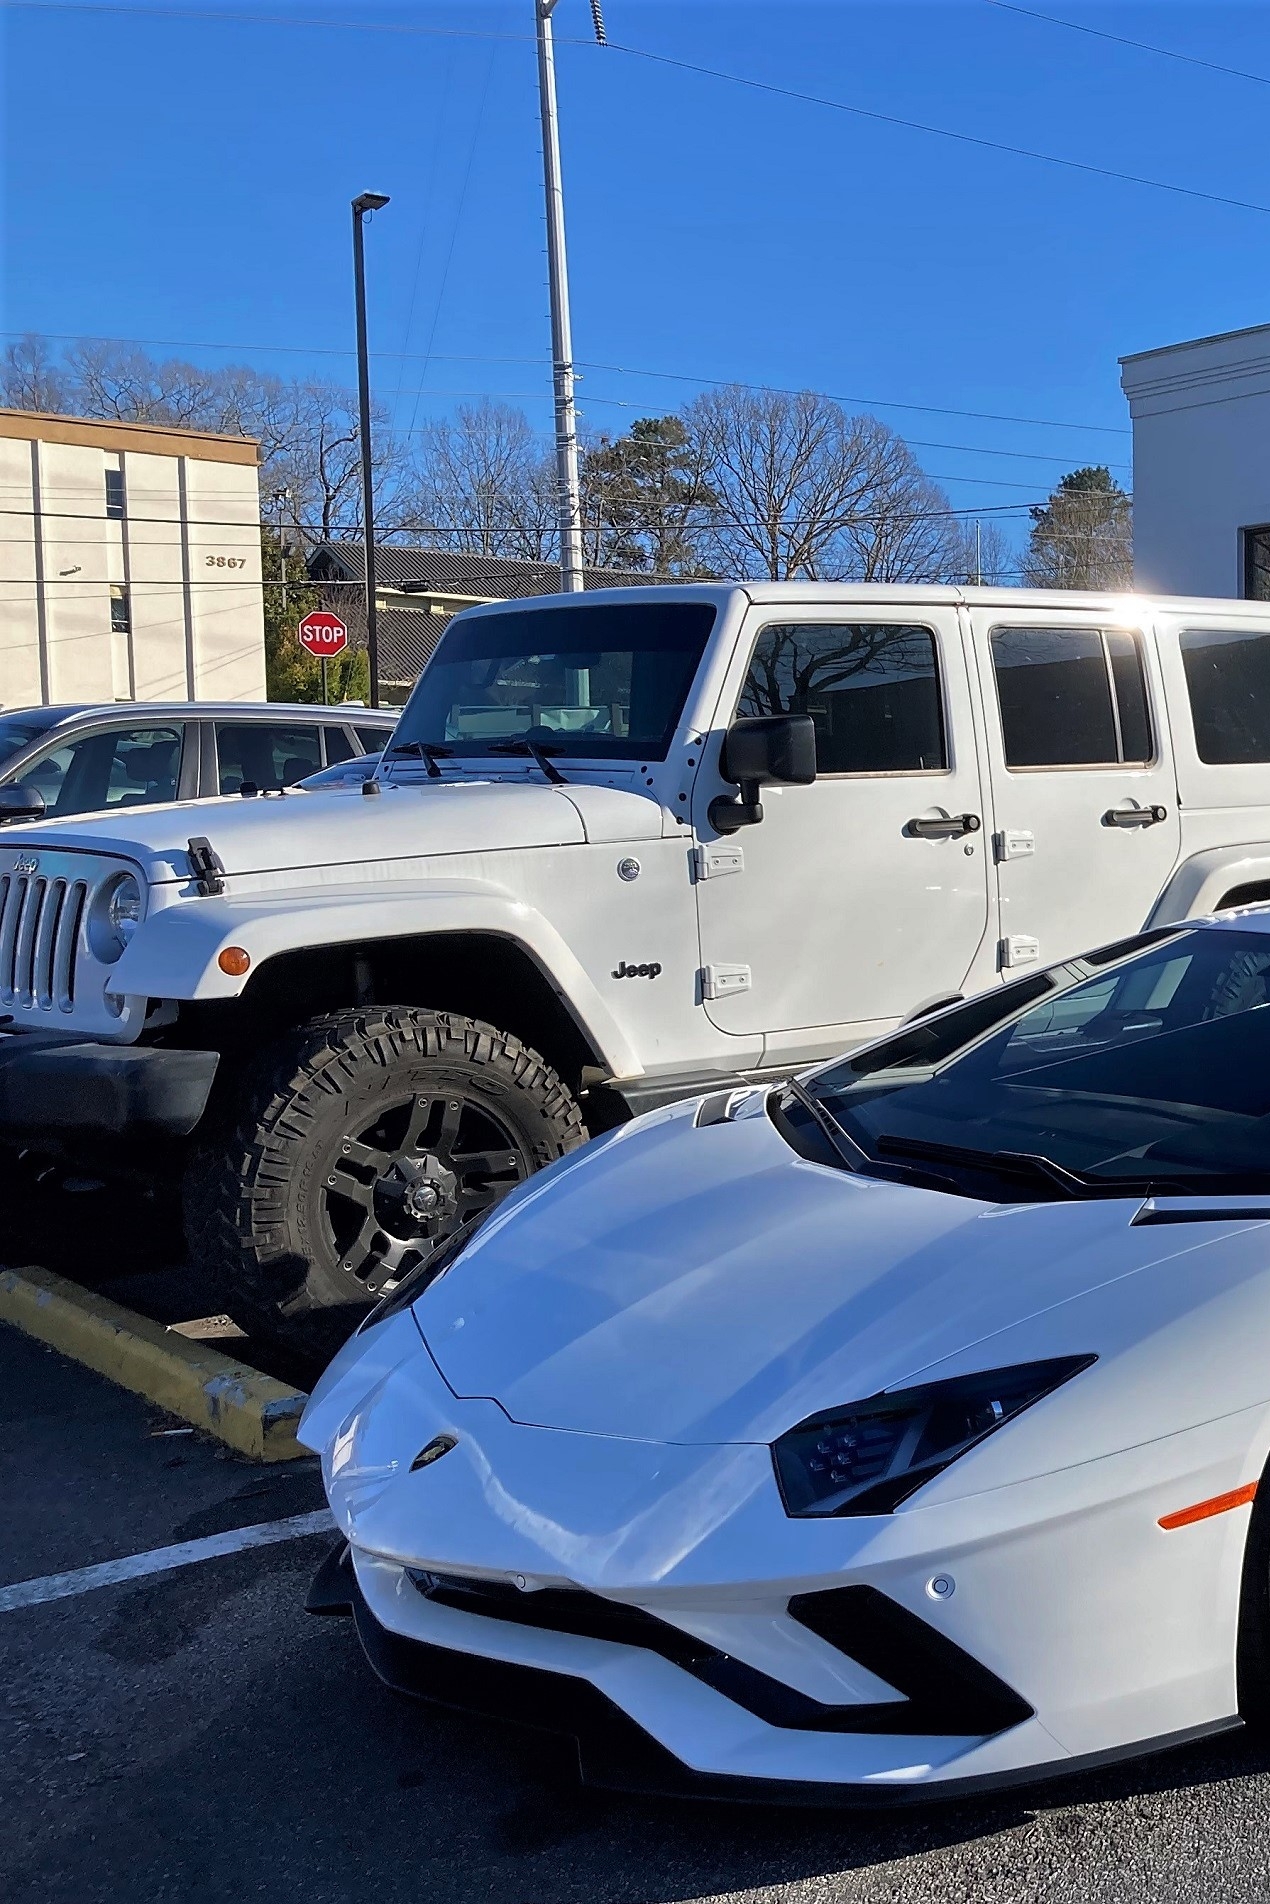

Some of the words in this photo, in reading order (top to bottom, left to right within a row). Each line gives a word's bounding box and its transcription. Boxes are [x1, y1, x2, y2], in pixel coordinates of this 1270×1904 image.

[205, 555, 247, 569] 3867
[303, 625, 344, 643] STOP
[13, 852, 40, 875] Jeep
[611, 961, 662, 980] Jeep
